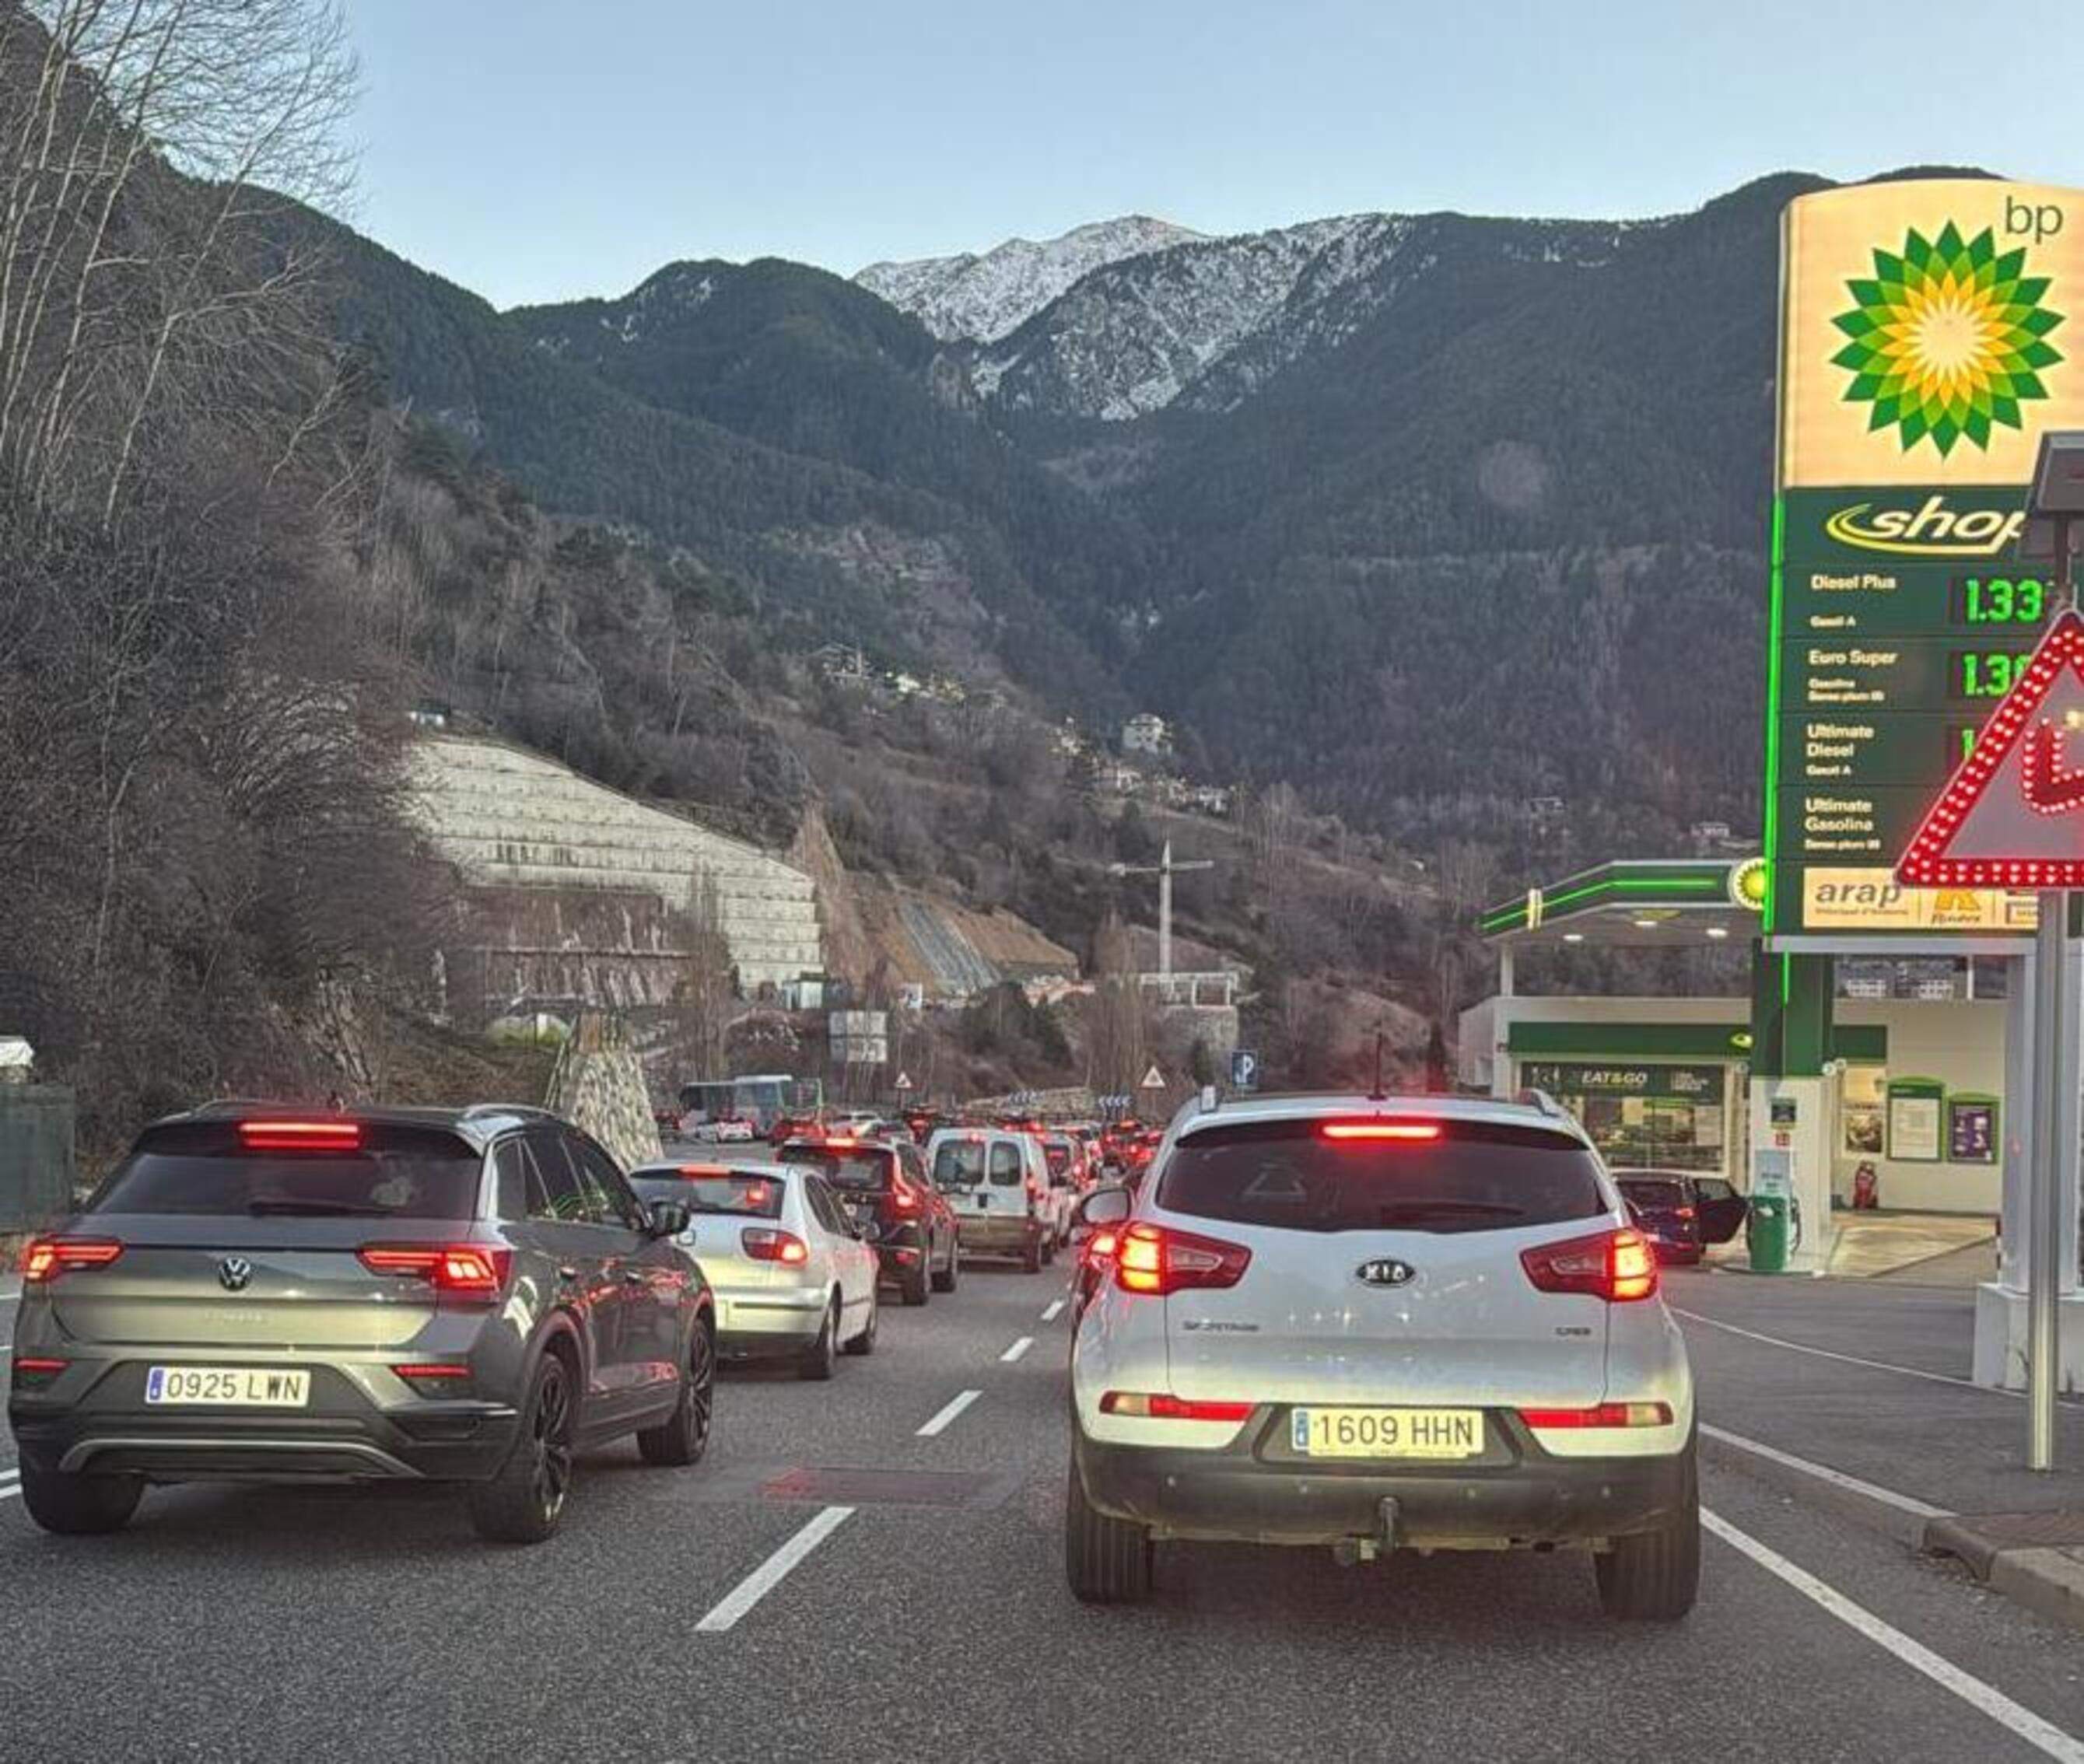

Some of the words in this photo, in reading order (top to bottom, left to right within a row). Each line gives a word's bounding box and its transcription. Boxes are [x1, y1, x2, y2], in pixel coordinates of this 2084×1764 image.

[2006, 195, 2064, 245] bp
[1810, 574, 1858, 590] Diesel
[1862, 574, 1897, 590] Plus
[1809, 649, 1847, 665] Euro
[1850, 649, 1897, 668] Super
[1808, 723, 1875, 739] Ultimate
[1807, 742, 1855, 758] Diesel
[1806, 796, 1873, 814] Ultimate
[1806, 816, 1874, 832] Gasolina
[1815, 883, 1900, 908] arap
[1364, 1265, 1406, 1280] KIA
[166, 1373, 237, 1399] 0925
[246, 1374, 302, 1400] LWN
[1321, 1415, 1399, 1444] 1609
[1410, 1416, 1473, 1445] HHN
